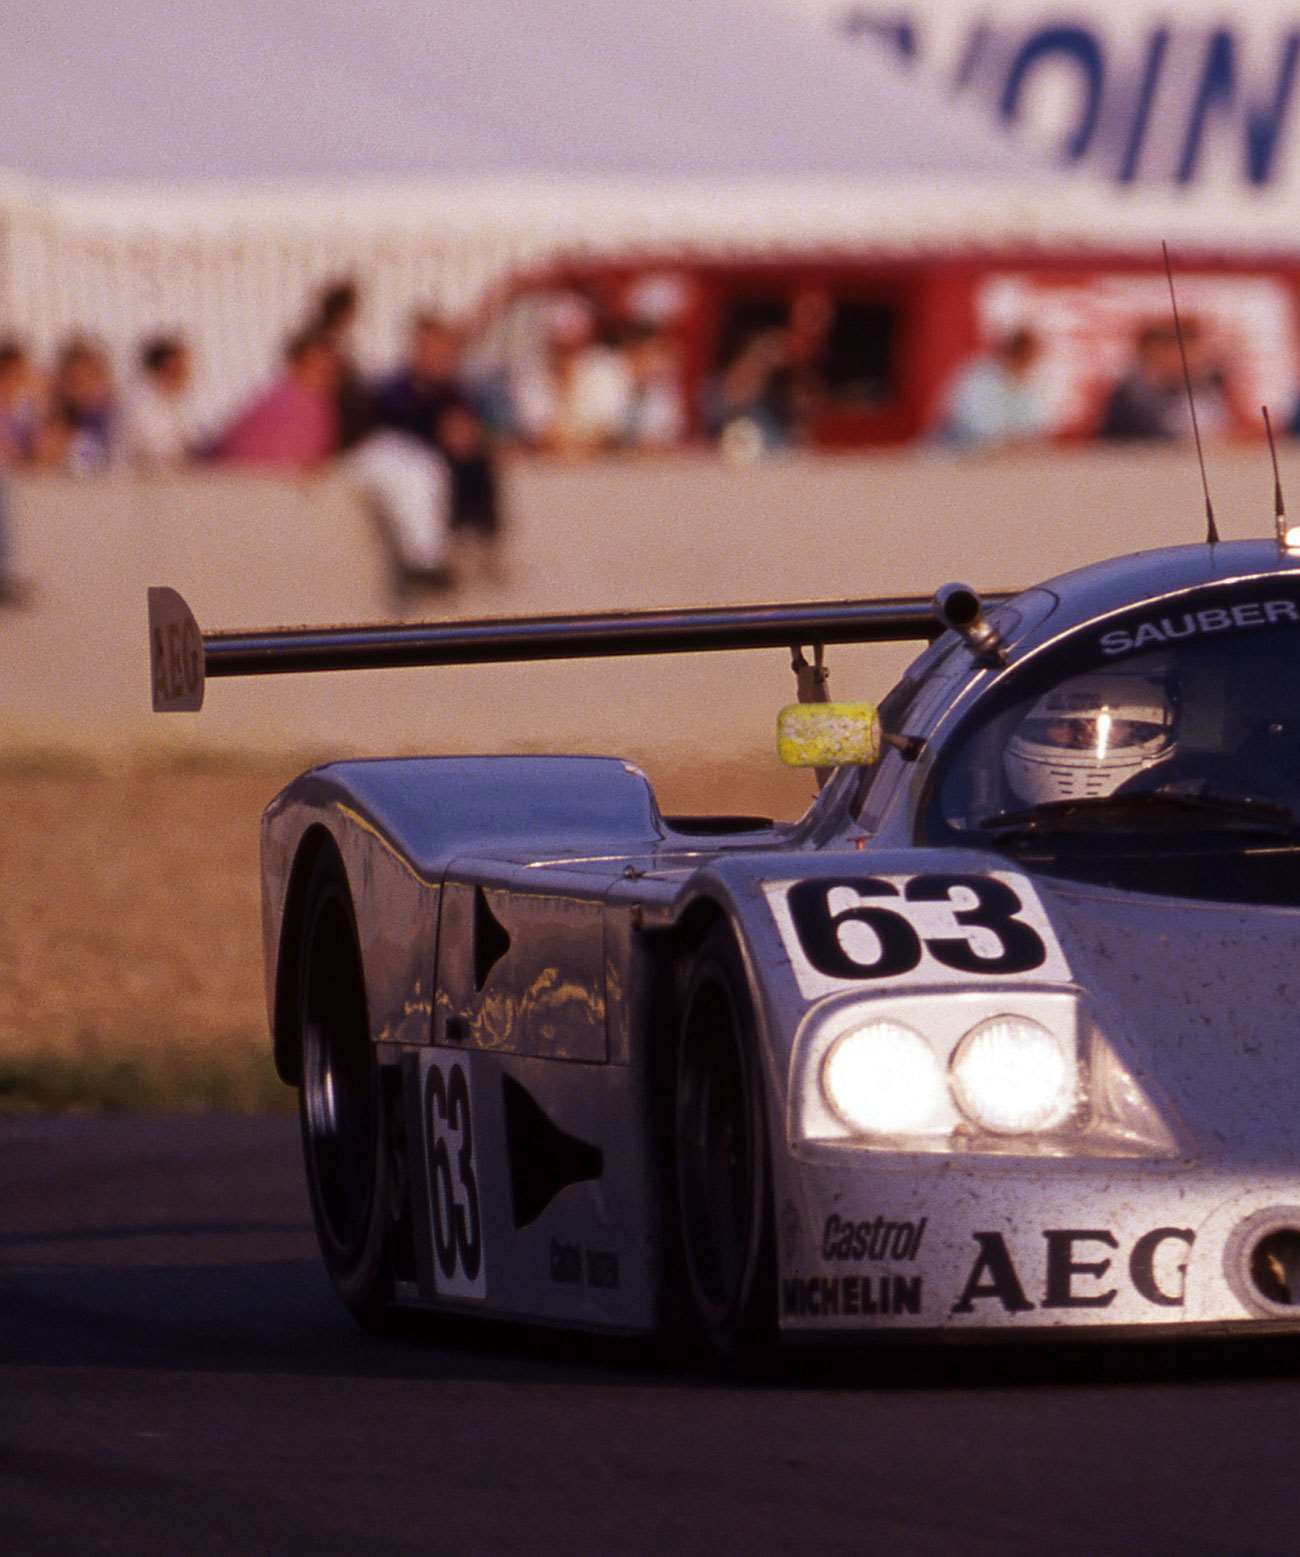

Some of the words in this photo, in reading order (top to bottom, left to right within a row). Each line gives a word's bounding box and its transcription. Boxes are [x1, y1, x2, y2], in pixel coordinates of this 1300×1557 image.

[1100, 597, 1299, 656] SAUBER
[786, 874, 1047, 980] 63
[422, 1062, 482, 1282] 63
[821, 1213, 928, 1262] Castrol
[951, 1227, 1197, 1314] AEG
